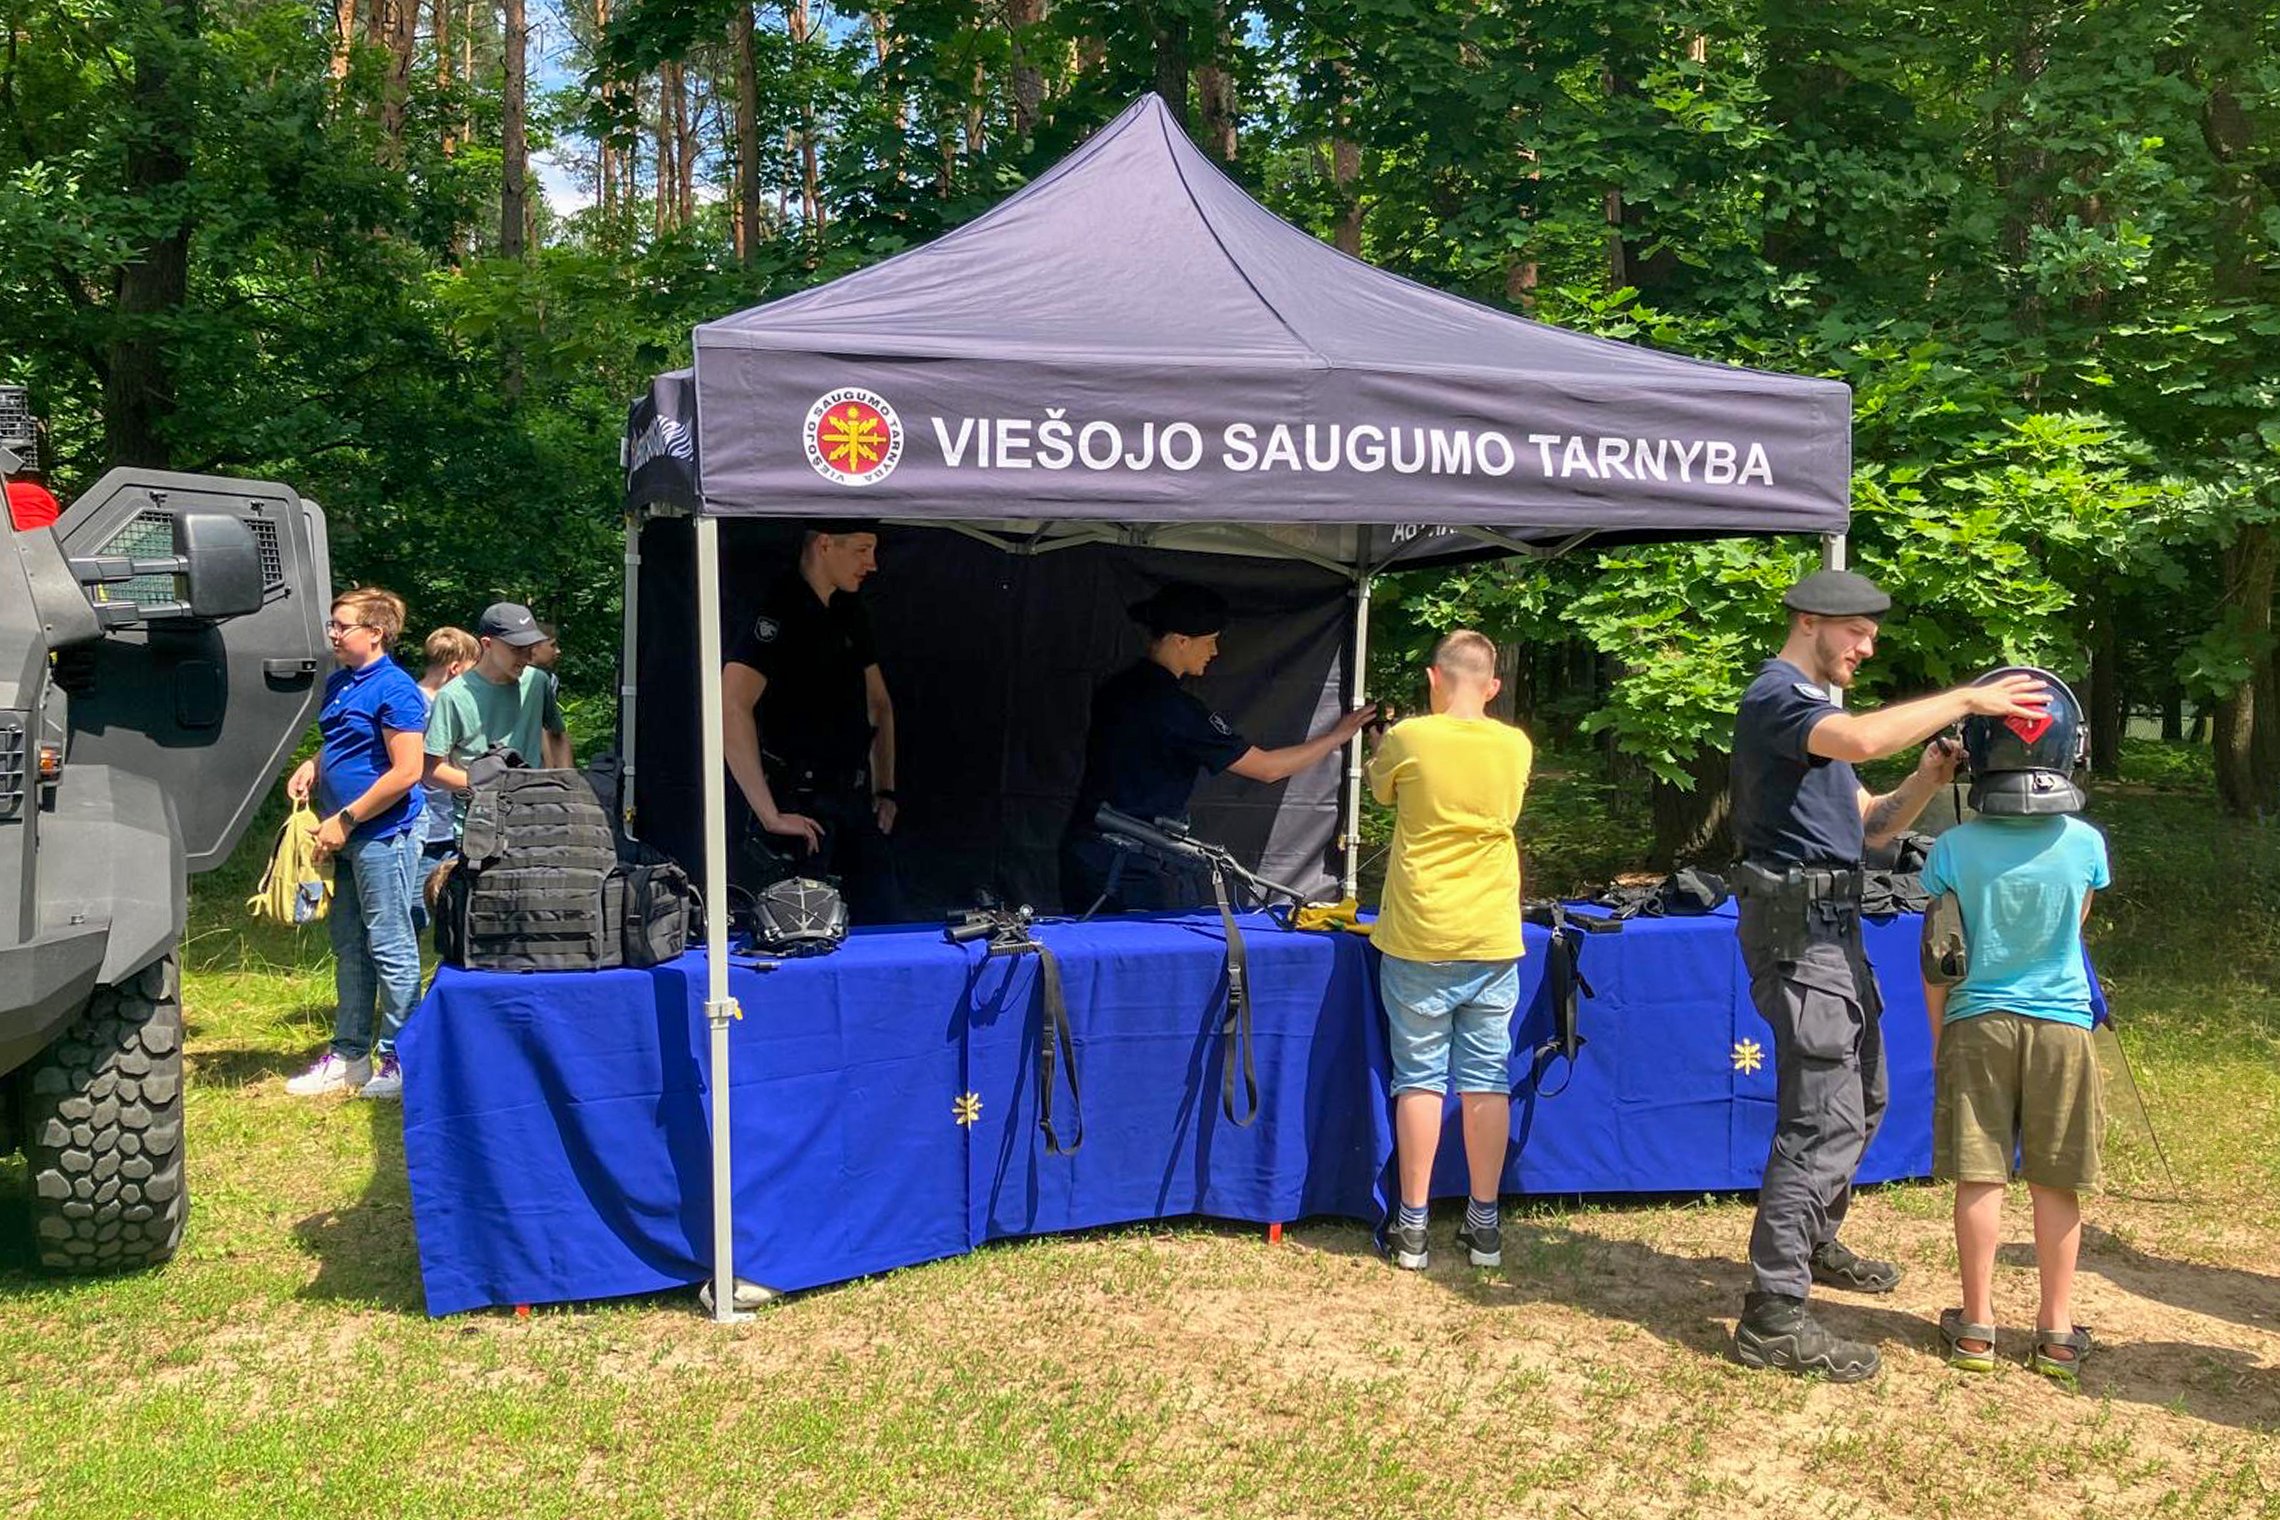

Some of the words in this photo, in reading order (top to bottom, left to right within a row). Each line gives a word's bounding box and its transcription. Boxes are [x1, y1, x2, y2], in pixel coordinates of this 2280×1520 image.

[814, 391, 890, 418] SAUGUMO
[864, 417, 901, 482] TARNYBA
[931, 408, 1203, 471] VIEŠOJO
[1222, 423, 1516, 476] SAUGUMO
[1528, 434, 1774, 486] TARNYBA
